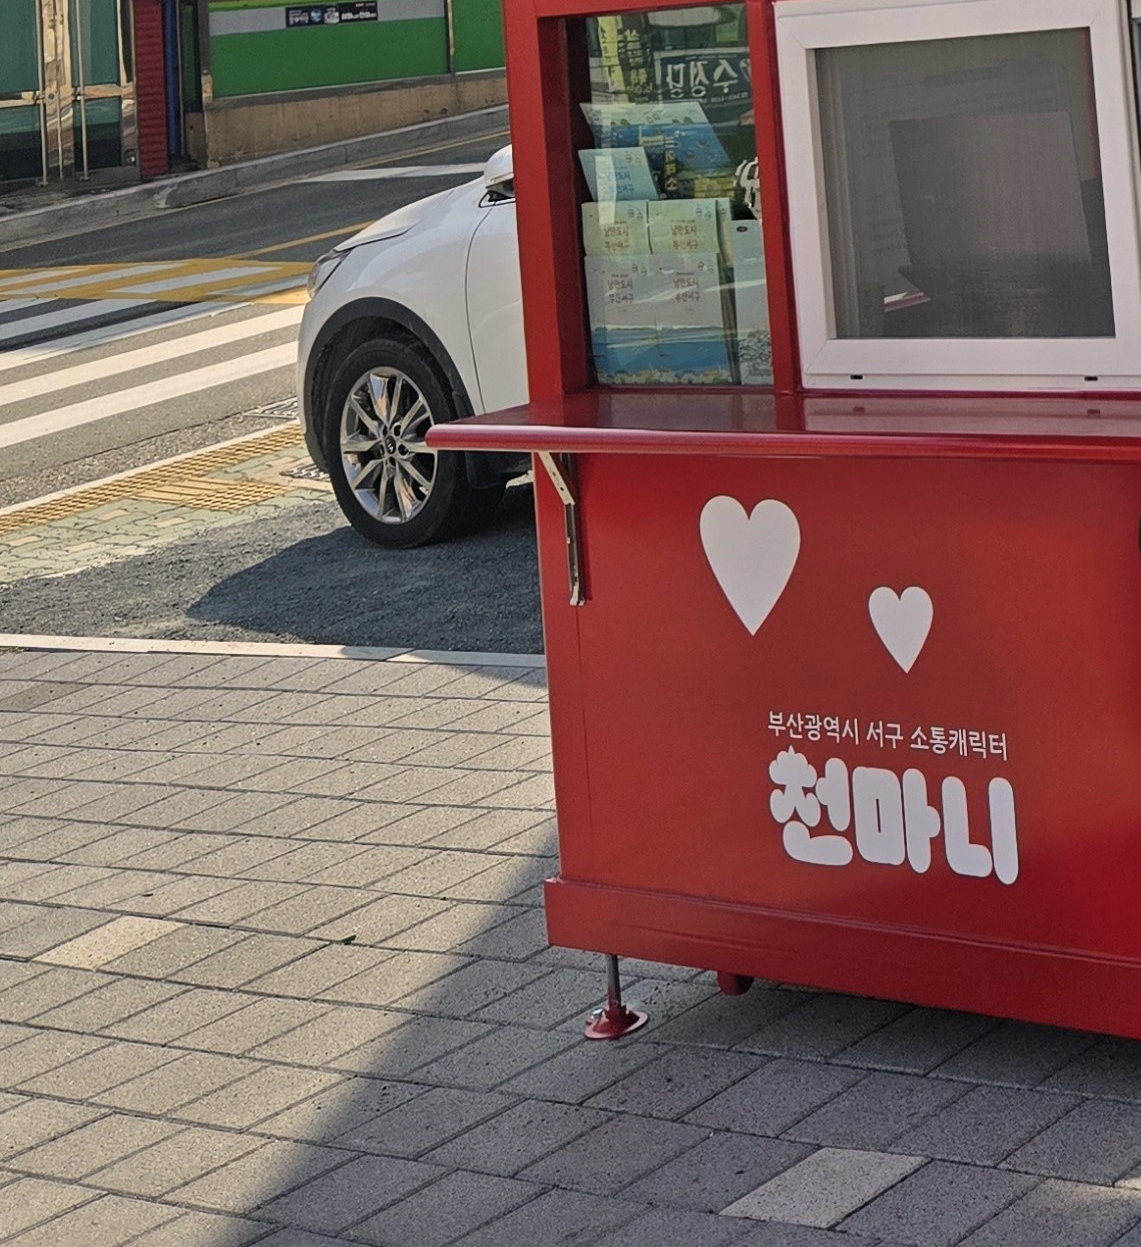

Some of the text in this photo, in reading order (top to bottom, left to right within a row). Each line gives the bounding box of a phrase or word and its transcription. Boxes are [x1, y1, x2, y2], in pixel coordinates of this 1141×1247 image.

[768, 711, 1008, 762] 부산광역시 서구 소통캐릭터
[769, 744, 1019, 886] 천마니
